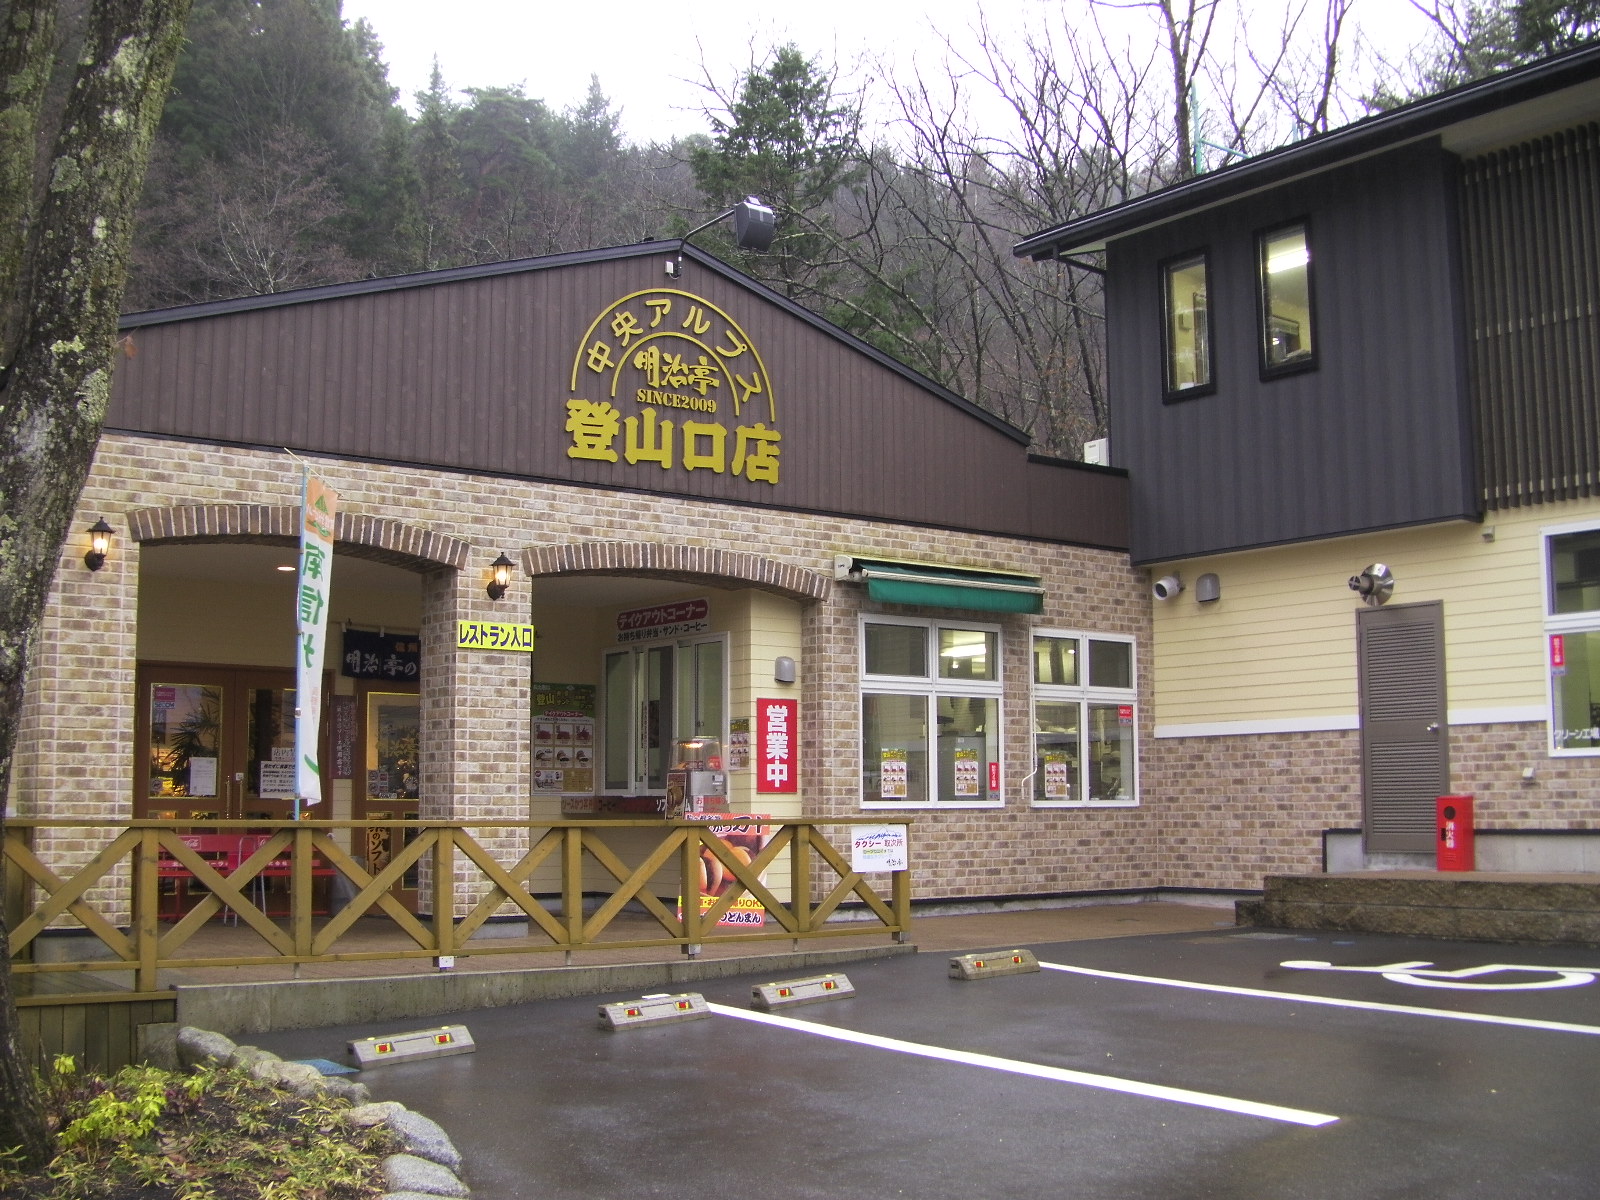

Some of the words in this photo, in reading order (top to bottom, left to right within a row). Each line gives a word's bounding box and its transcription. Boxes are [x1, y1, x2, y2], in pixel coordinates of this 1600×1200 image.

[587, 298, 762, 404] 中央アルプス
[633, 345, 720, 396] 明治亭
[636, 388, 717, 414] SINCE2009
[565, 398, 782, 485] 登山口店
[618, 603, 707, 629] テイクアウトコーナー
[459, 624, 533, 649] レストラン入口
[345, 649, 417, 677] 明治亭の
[766, 704, 789, 788] 営業中
[854, 840, 882, 849] タクシー
[884, 838, 904, 848] 取次所
[1445, 821, 1455, 849] 消火器
